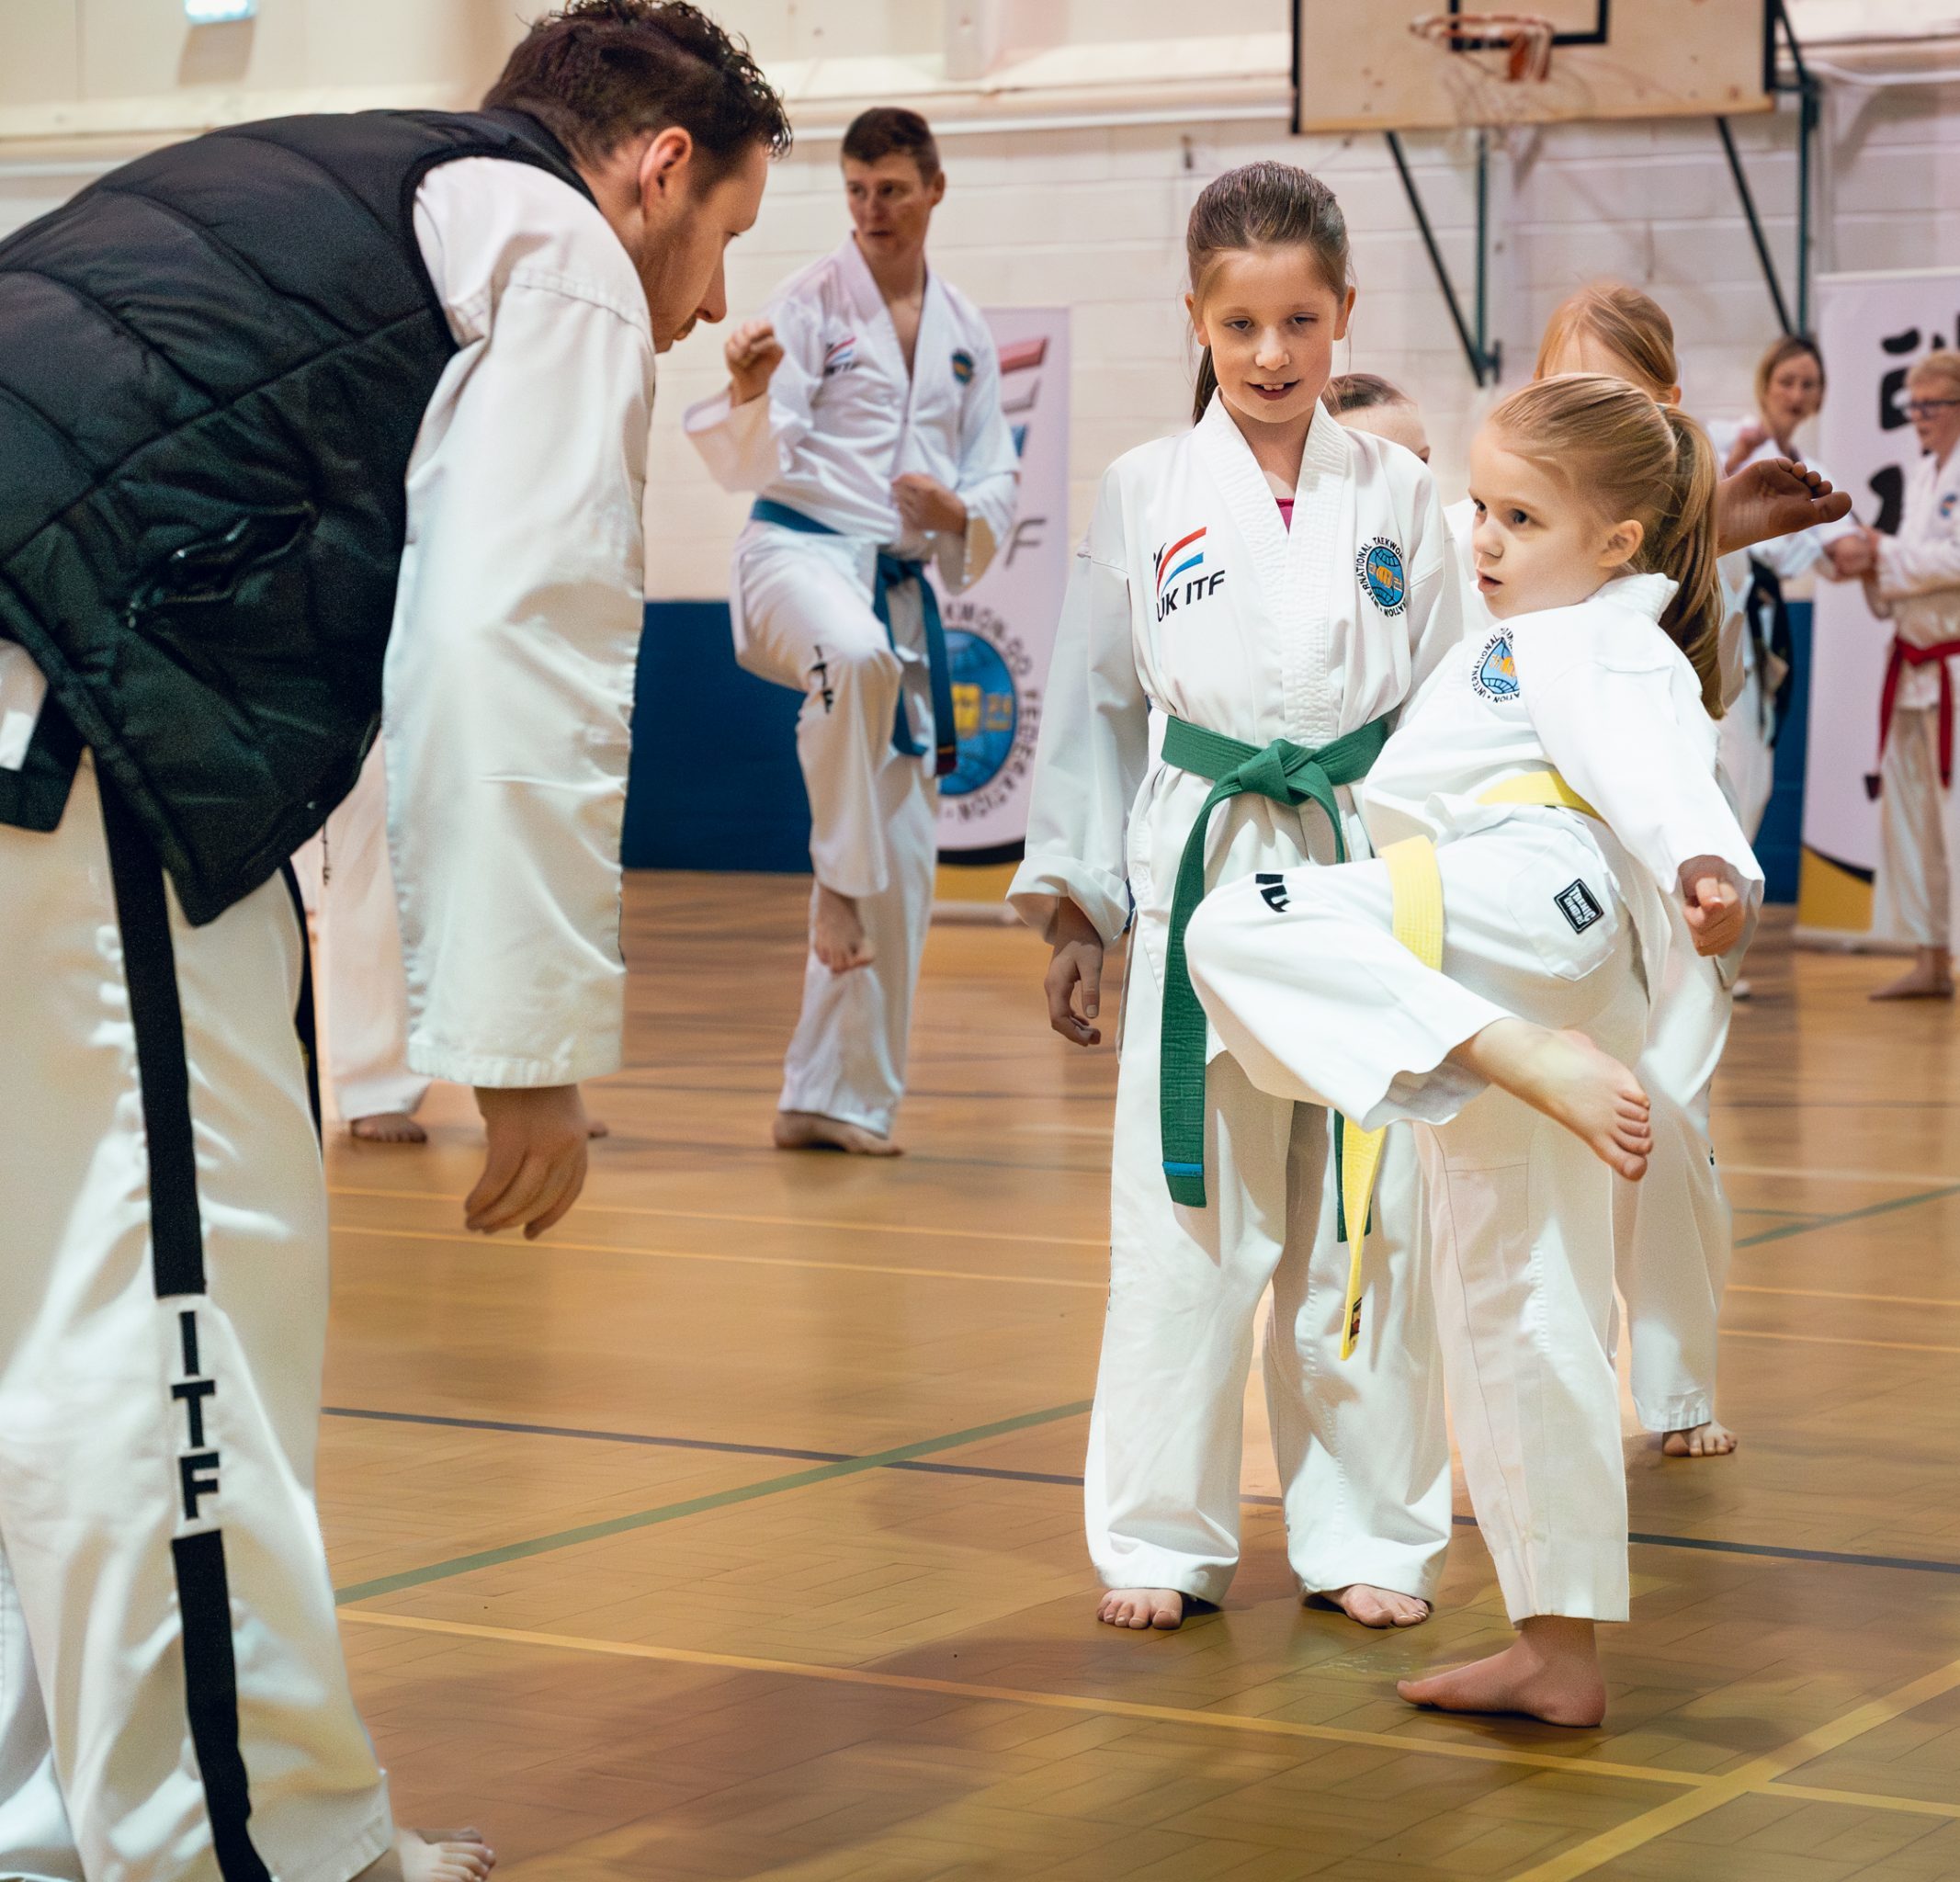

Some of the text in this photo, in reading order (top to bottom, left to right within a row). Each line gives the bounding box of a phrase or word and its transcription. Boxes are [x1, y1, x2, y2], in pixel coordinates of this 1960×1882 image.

[1156, 570, 1225, 622] UK ITF
[1356, 543, 1378, 610] INTERNATIONAL
[171, 1310, 220, 1521] ITF
